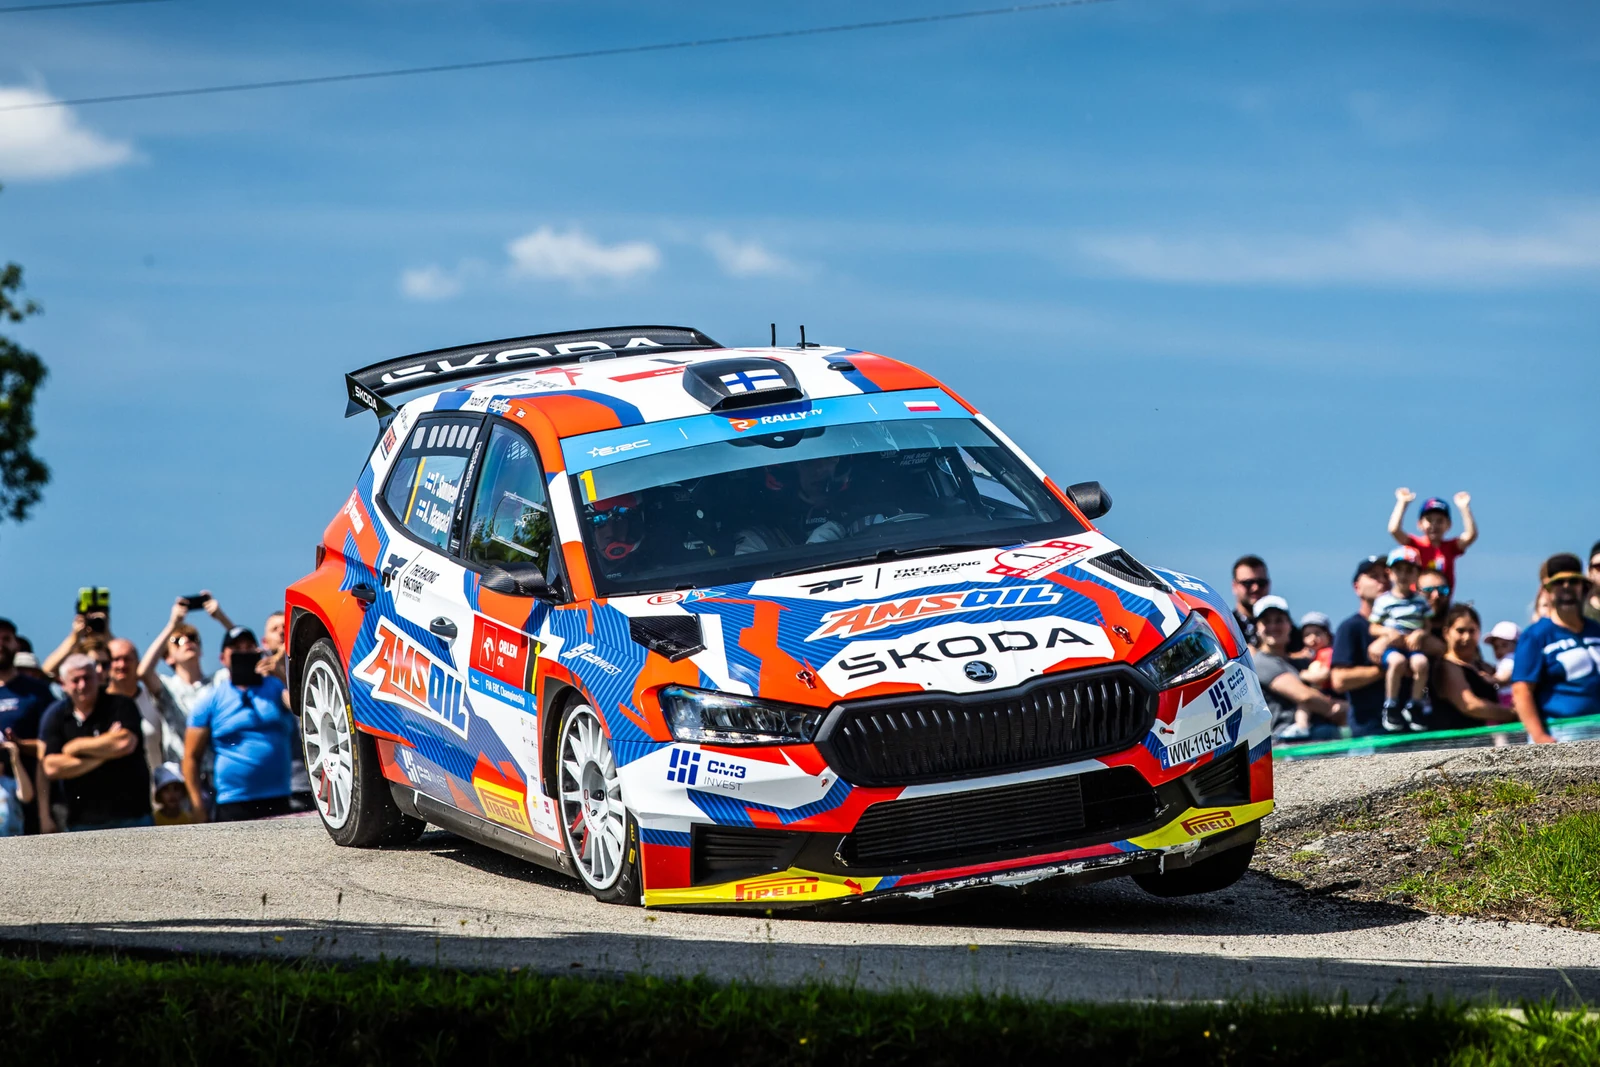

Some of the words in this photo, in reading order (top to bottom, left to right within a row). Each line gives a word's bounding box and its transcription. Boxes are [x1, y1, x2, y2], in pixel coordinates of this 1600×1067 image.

[354, 385, 379, 411] SKODA
[760, 411, 808, 424] RALLY
[580, 470, 598, 502] 1
[895, 566, 925, 574] THE
[927, 560, 981, 571] RACING
[1012, 552, 1047, 560] 1
[893, 567, 960, 578] FACTORY
[816, 585, 1056, 638] AMSOIL
[498, 639, 519, 659] ORLEN
[838, 627, 1094, 680] SKODA
[363, 623, 466, 732] AMSOIL
[1227, 668, 1245, 690] CM3
[1233, 683, 1249, 703] INVEST
[1169, 724, 1227, 764] WW-119-ZY
[707, 760, 747, 779] CM3
[703, 776, 743, 791] INVEST
[478, 787, 527, 827] PIRELLI
[1180, 810, 1236, 836] PIRELLI
[735, 876, 820, 903] PIRELLI
